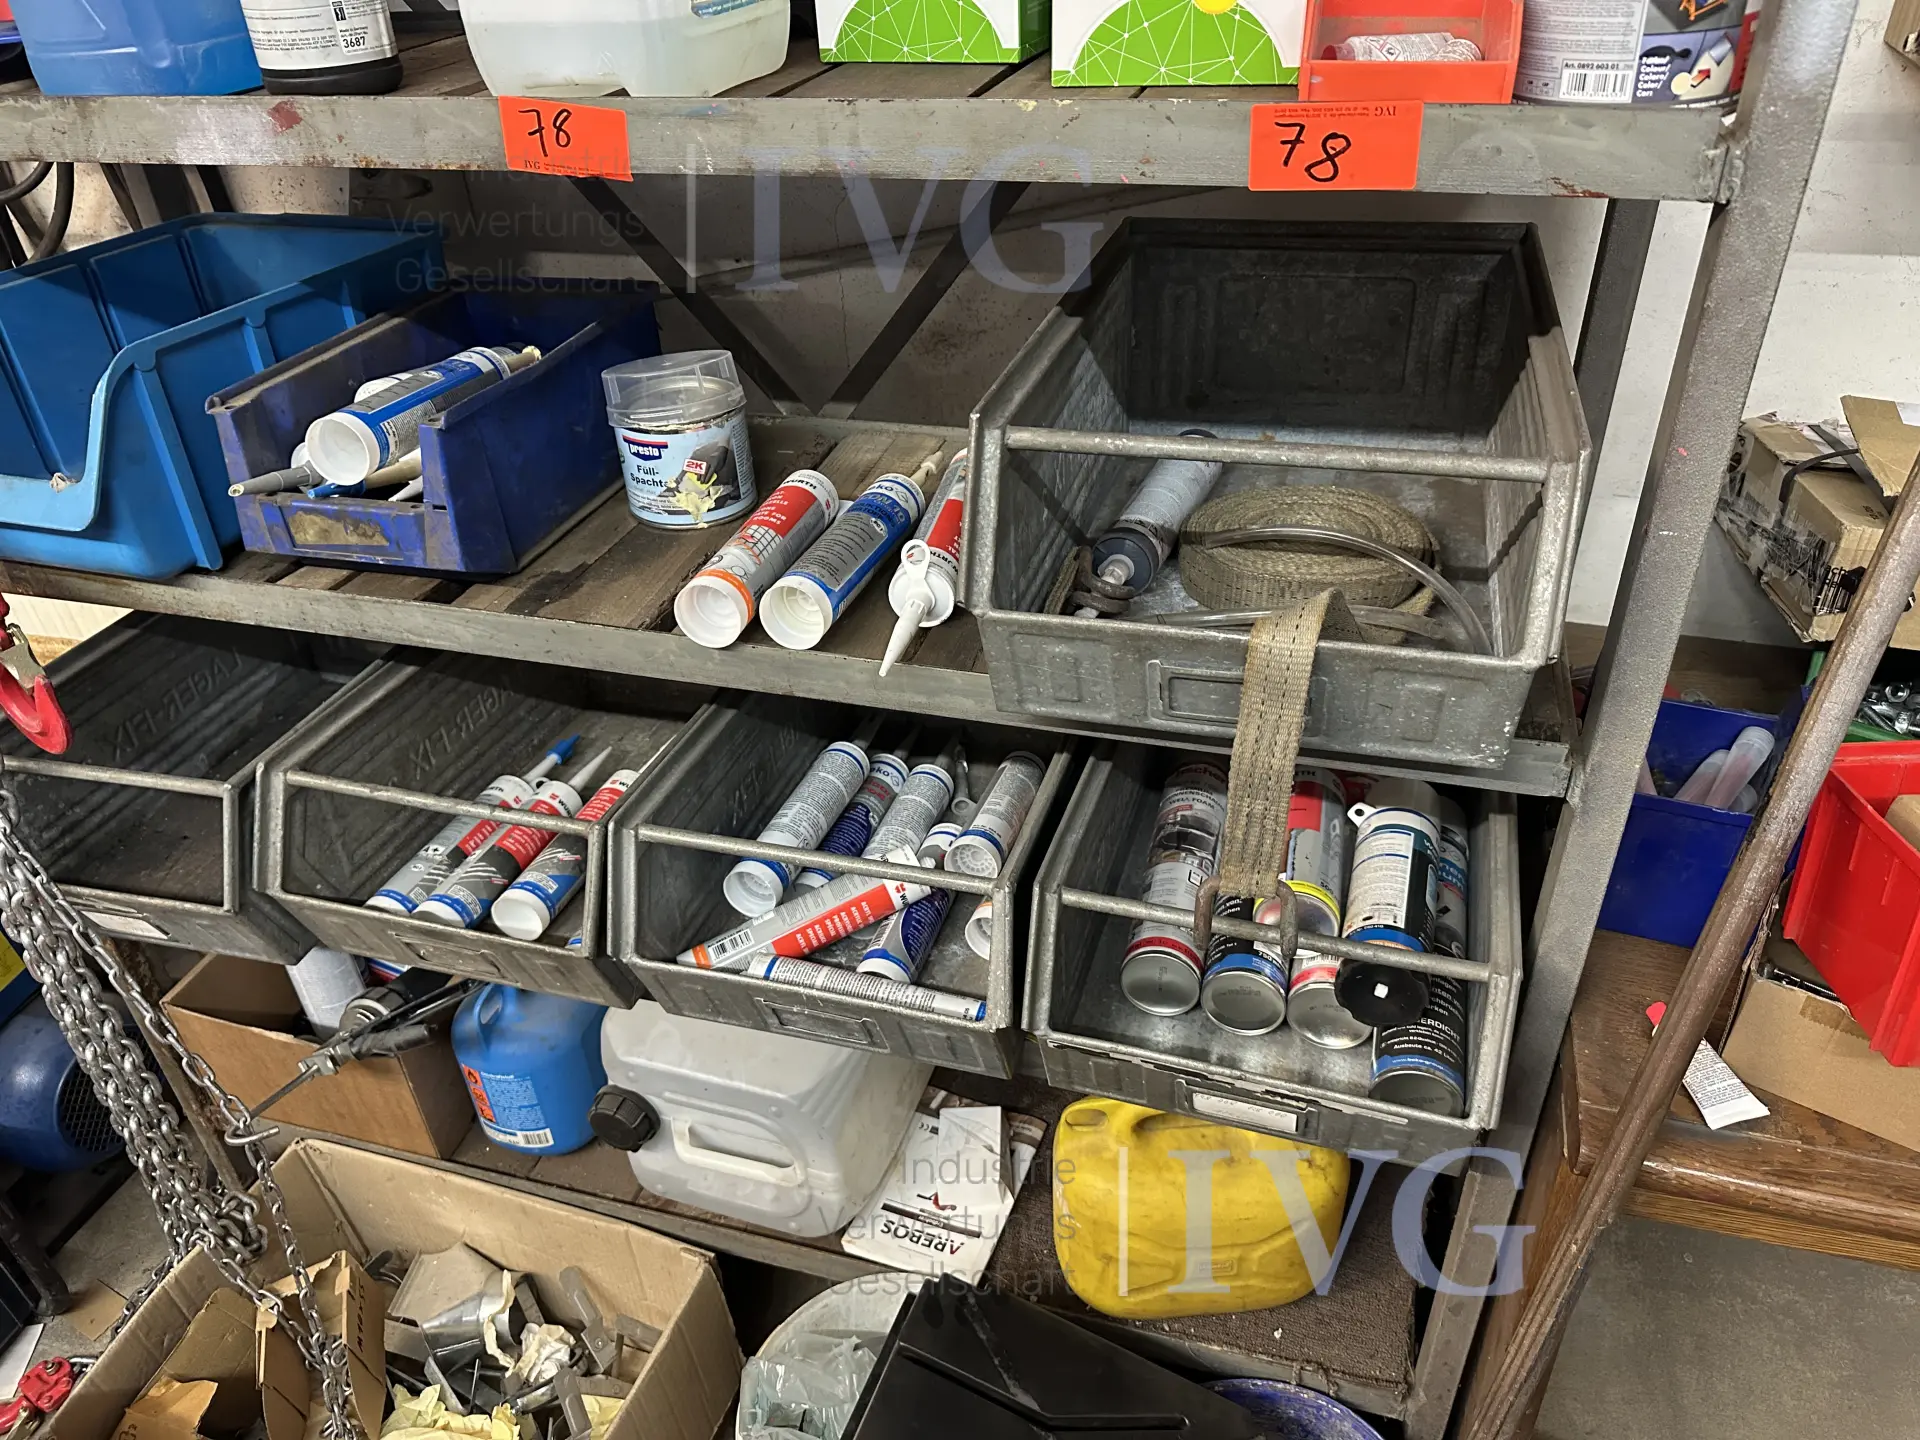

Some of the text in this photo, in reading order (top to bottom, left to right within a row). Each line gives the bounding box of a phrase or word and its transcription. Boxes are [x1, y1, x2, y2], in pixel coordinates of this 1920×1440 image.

[342, 36, 366, 48] 3687
[1374, 106, 1396, 117] IVG
[518, 108, 572, 157] 78
[1274, 122, 1352, 182] 78
[524, 160, 542, 170] IVG
[630, 444, 660, 456] presto
[637, 465, 660, 476] Füll-
[686, 461, 704, 470] 2K
[1192, 798, 1215, 810] FOAM
[1258, 951, 1272, 962] 750
[1419, 1017, 1460, 1042] ERDICHT
[880, 1218, 966, 1256] AREBOS
